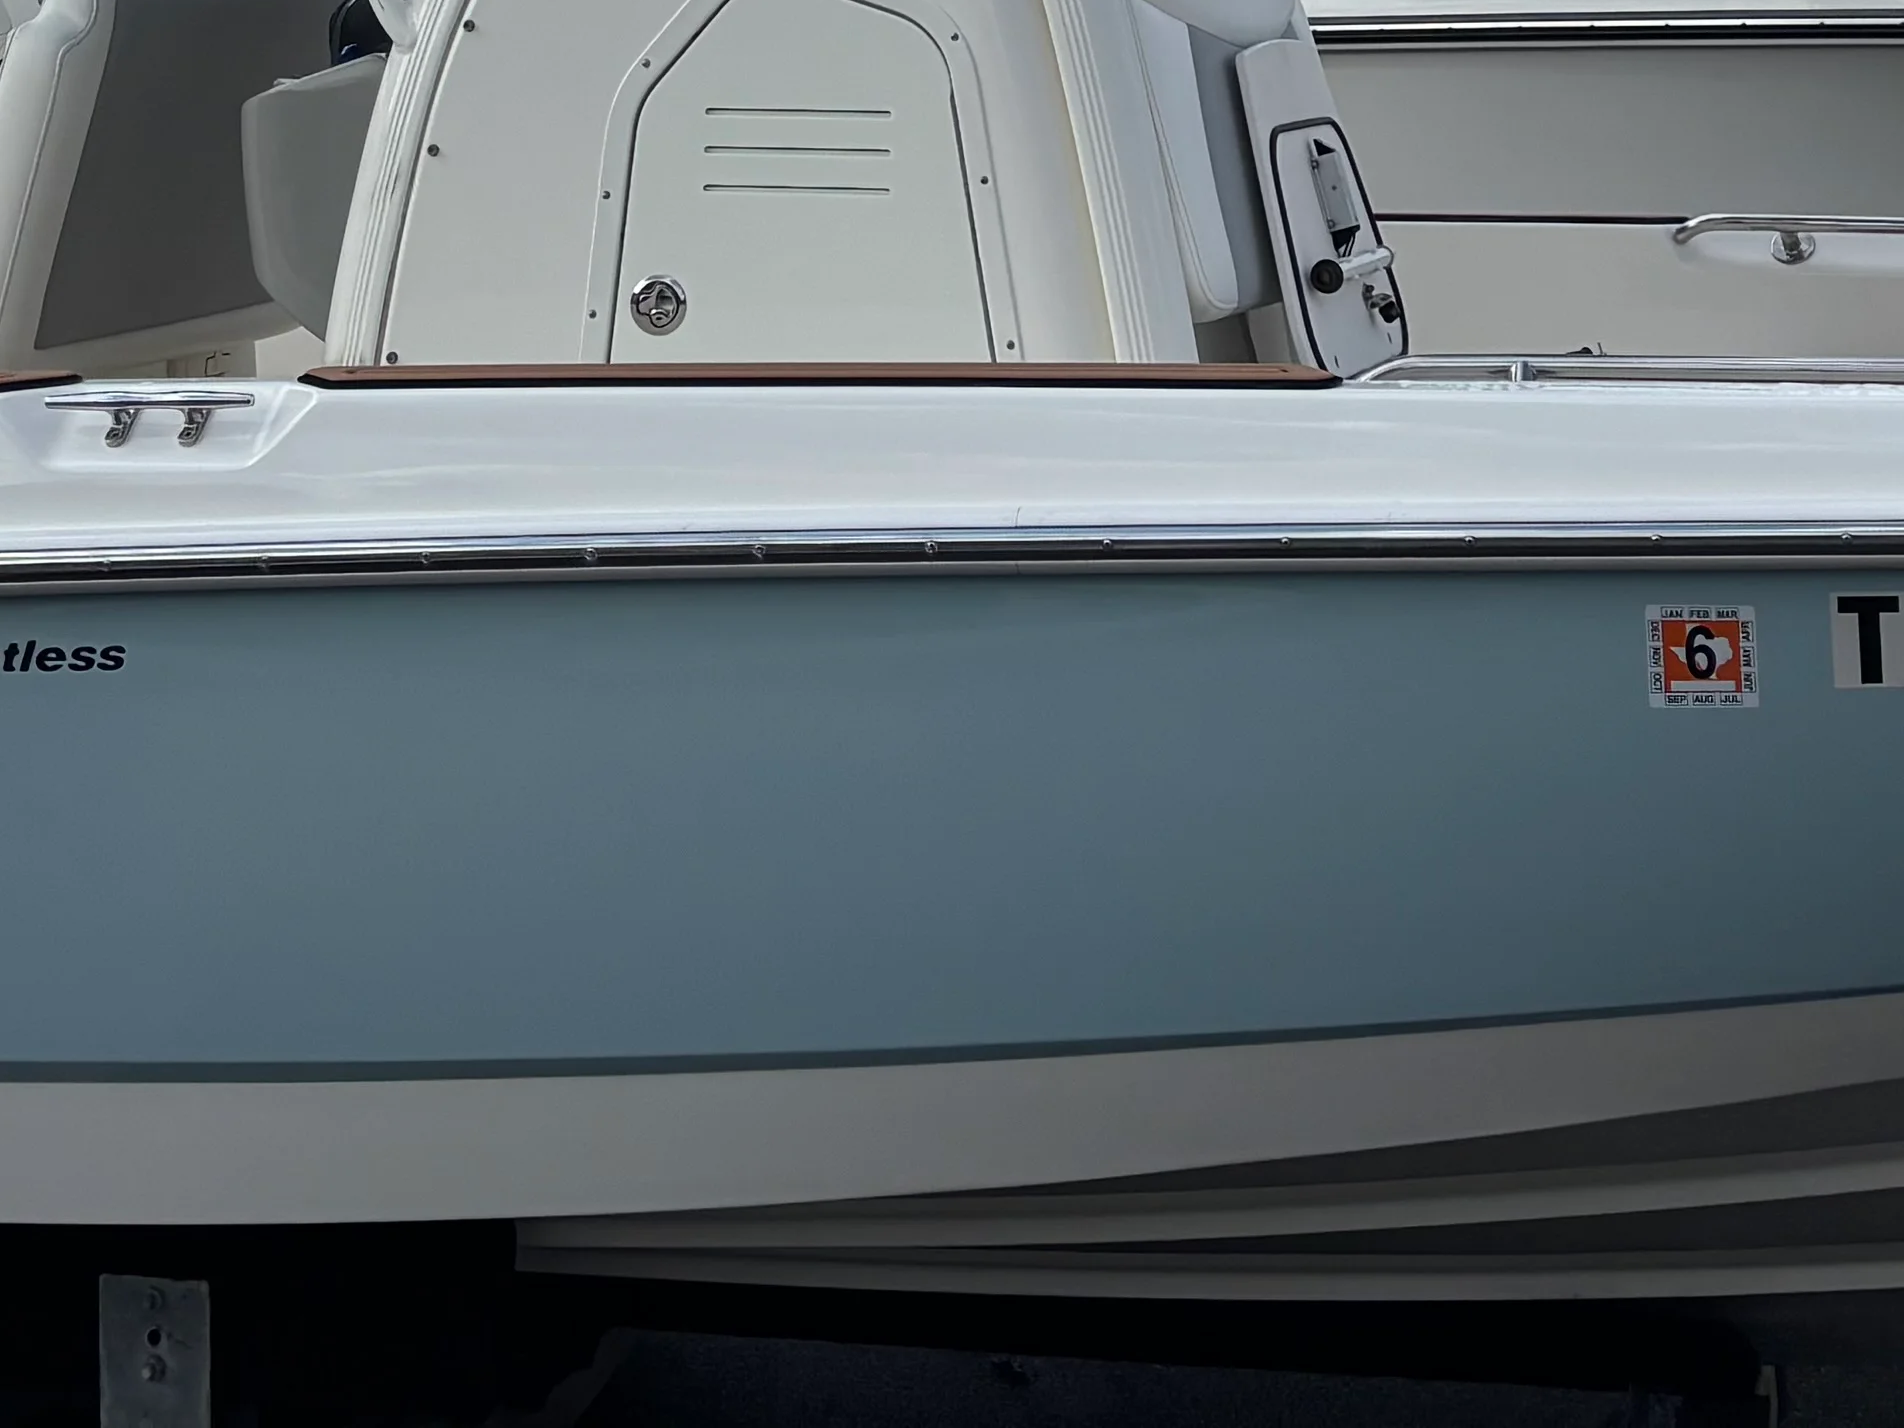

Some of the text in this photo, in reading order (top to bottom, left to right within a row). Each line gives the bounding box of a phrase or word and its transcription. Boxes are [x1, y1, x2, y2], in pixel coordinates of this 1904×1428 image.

[1663, 609, 1684, 618] JAN
[1690, 609, 1710, 619] FEB
[1685, 625, 1717, 680] 6
[1653, 673, 1662, 691] OCT
[1667, 695, 1741, 704] SEP AUG JUL
